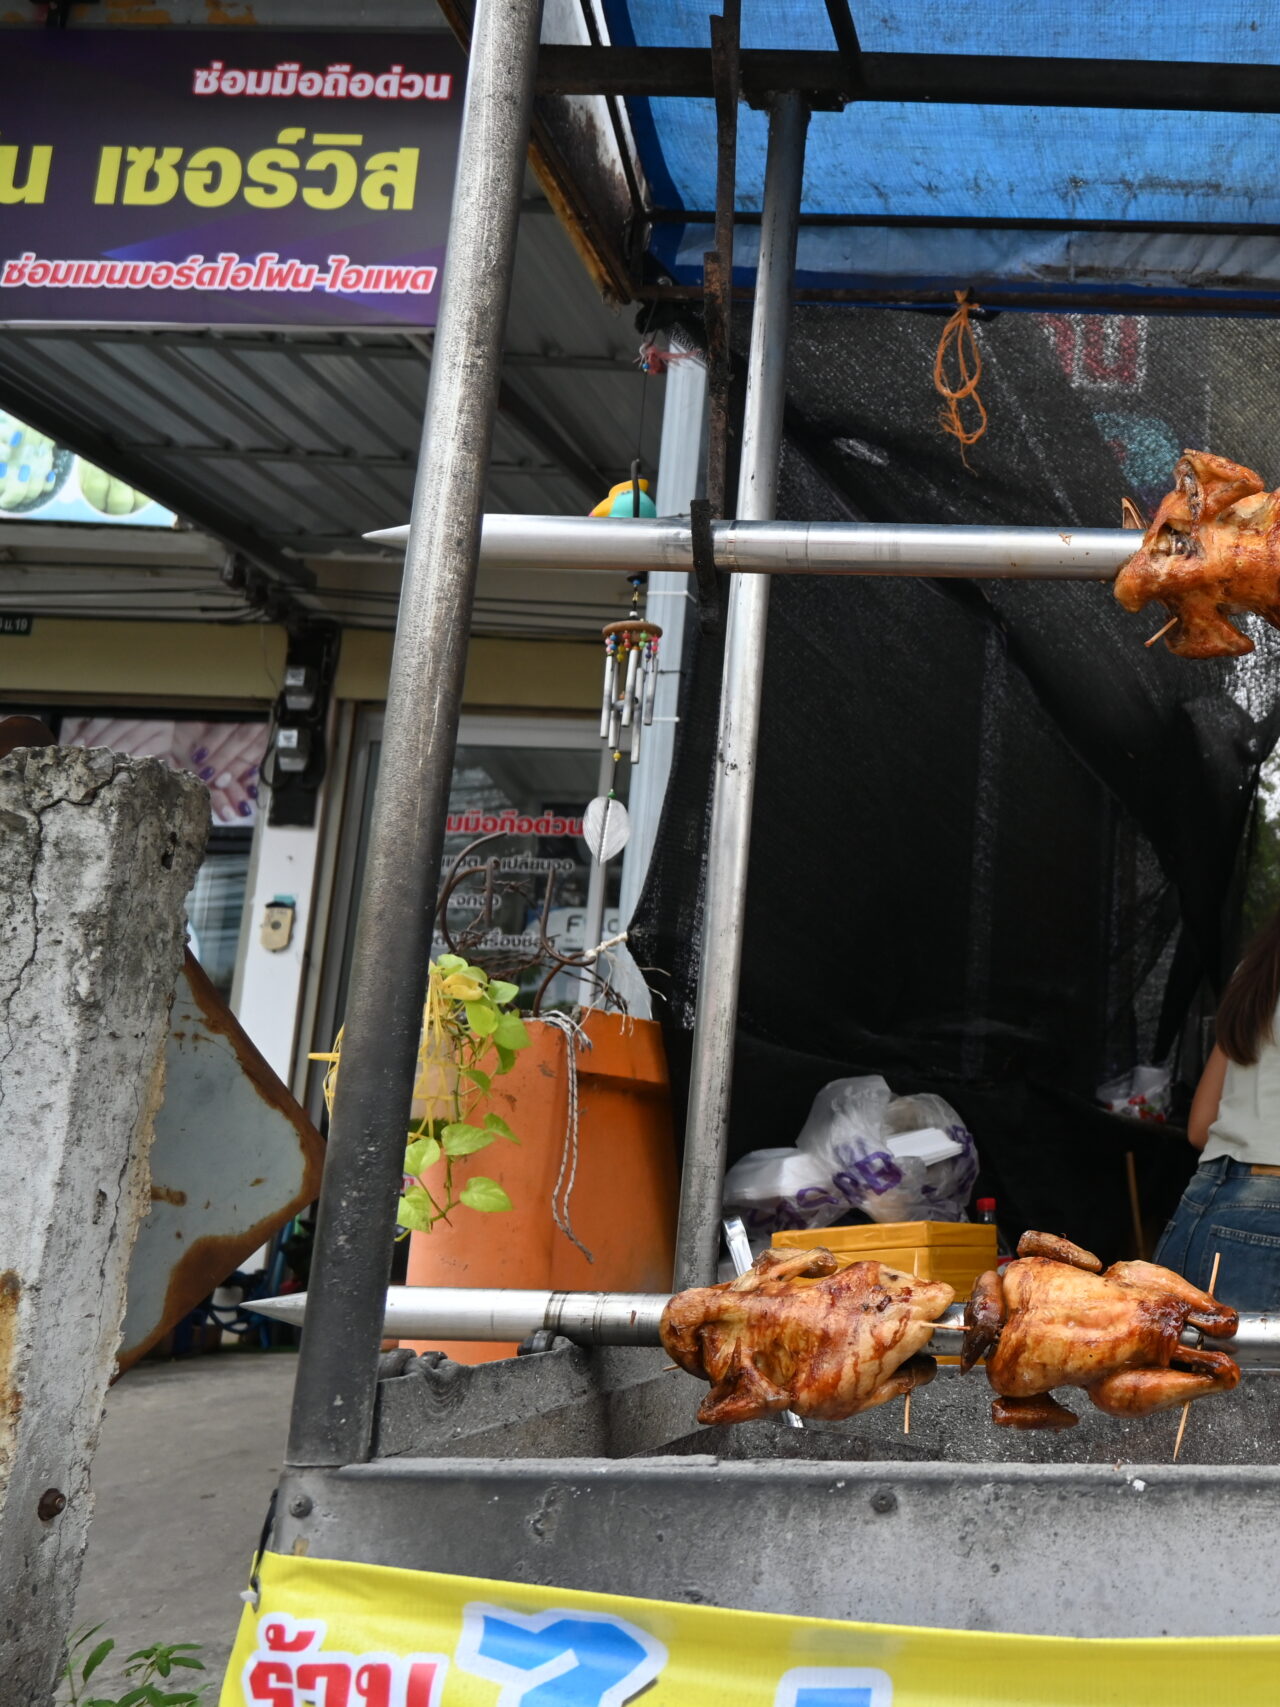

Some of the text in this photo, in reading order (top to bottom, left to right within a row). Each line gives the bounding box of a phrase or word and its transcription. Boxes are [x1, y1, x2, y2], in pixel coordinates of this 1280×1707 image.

[194, 61, 451, 98] ซ่อมมือถือด่วน
[94, 127, 420, 210] เซอร์วิส
[2, 253, 438, 294] ซ่อมเมนบอร์ดไอโฟน-ไอแพด
